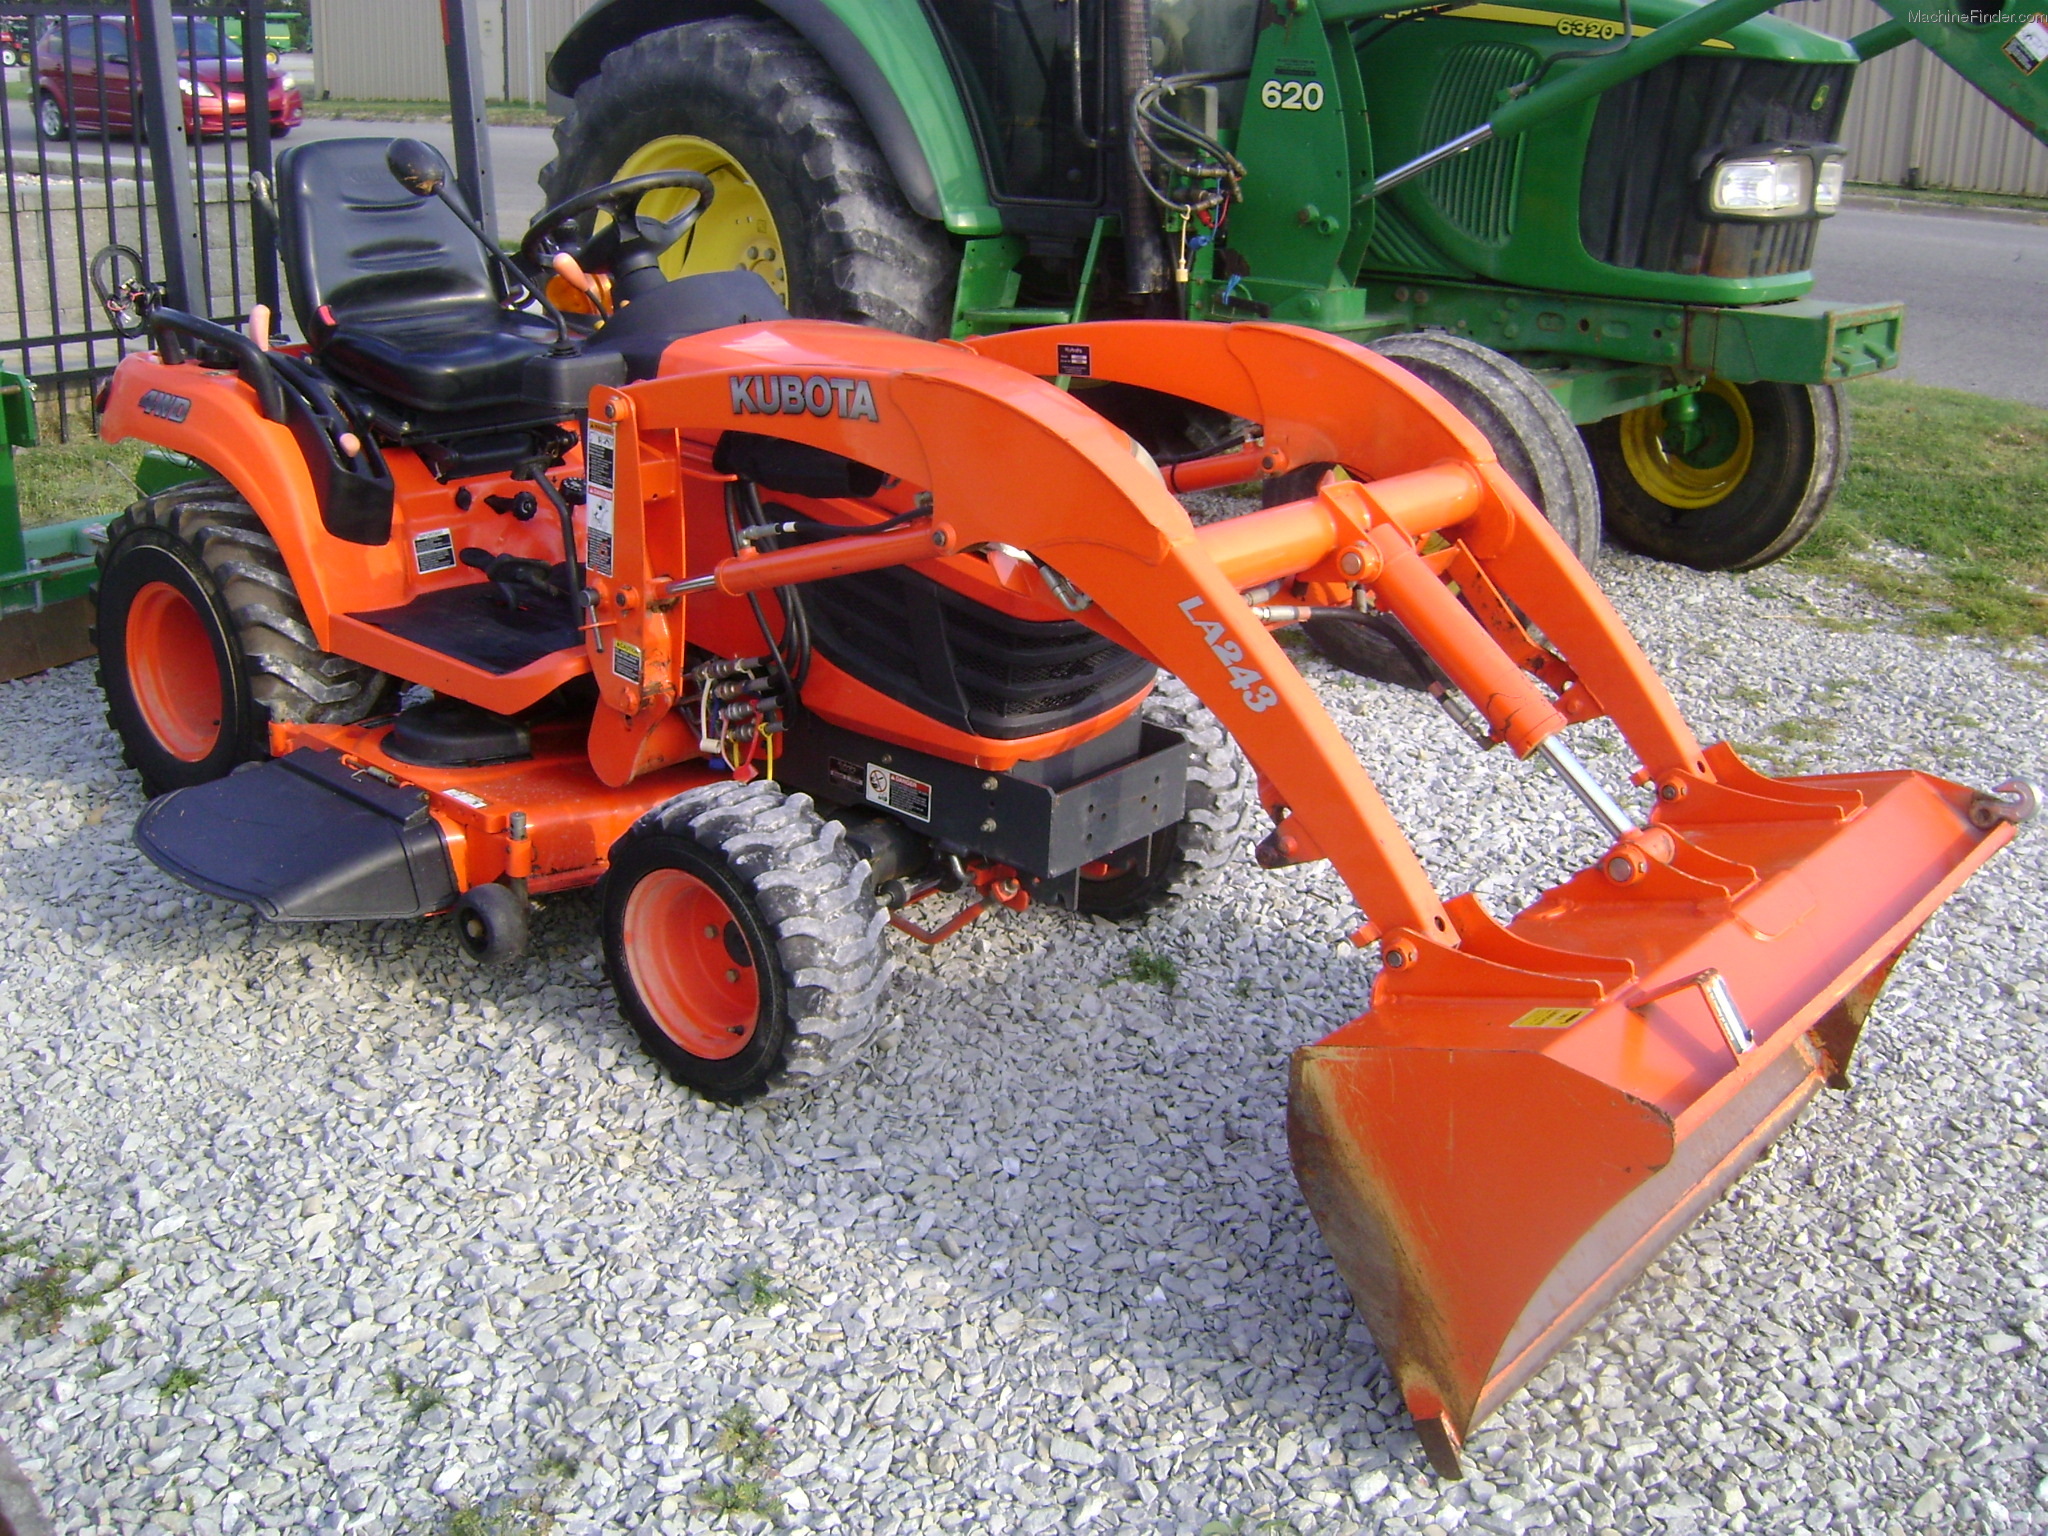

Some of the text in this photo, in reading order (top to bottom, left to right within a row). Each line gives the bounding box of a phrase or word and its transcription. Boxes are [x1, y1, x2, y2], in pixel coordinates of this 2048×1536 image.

[1557, 19, 1615, 40] 6320
[1261, 79, 1324, 111] 620
[138, 389, 191, 423] 4WD
[730, 374, 879, 422] KUBOTA
[1178, 596, 1278, 712] LA243
